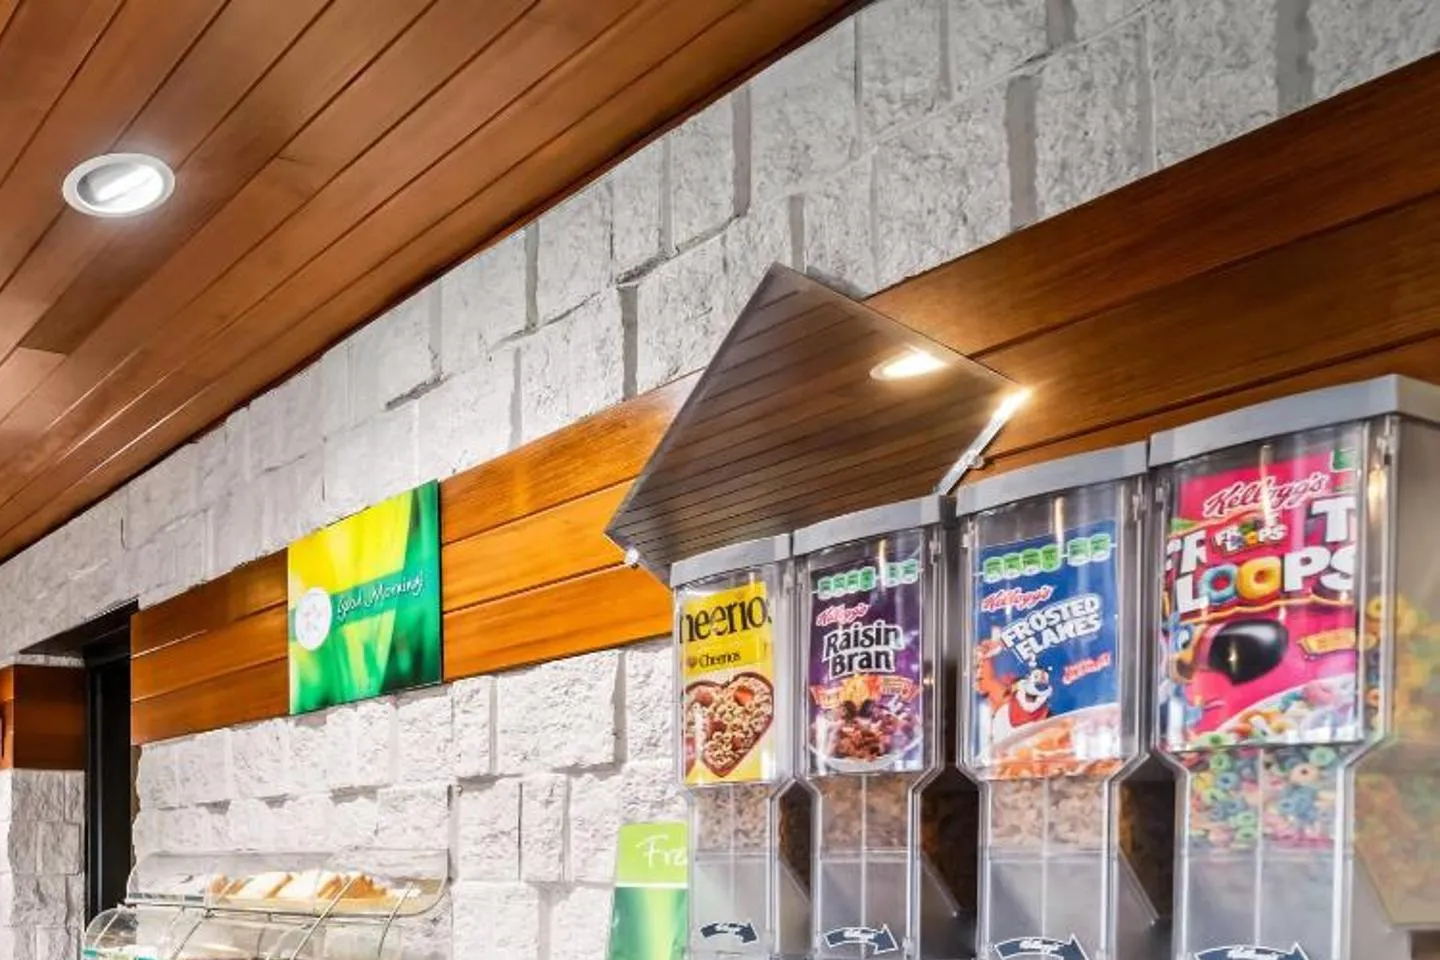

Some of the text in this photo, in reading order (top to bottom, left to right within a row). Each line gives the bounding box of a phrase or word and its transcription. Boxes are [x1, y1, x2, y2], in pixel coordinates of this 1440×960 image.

[1203, 472, 1329, 518] Kellogg's
[822, 620, 905, 661] Raisin
[1001, 594, 1101, 648] FROSTED
[1015, 613, 1102, 663] FLAKES
[830, 648, 894, 679] Bran
